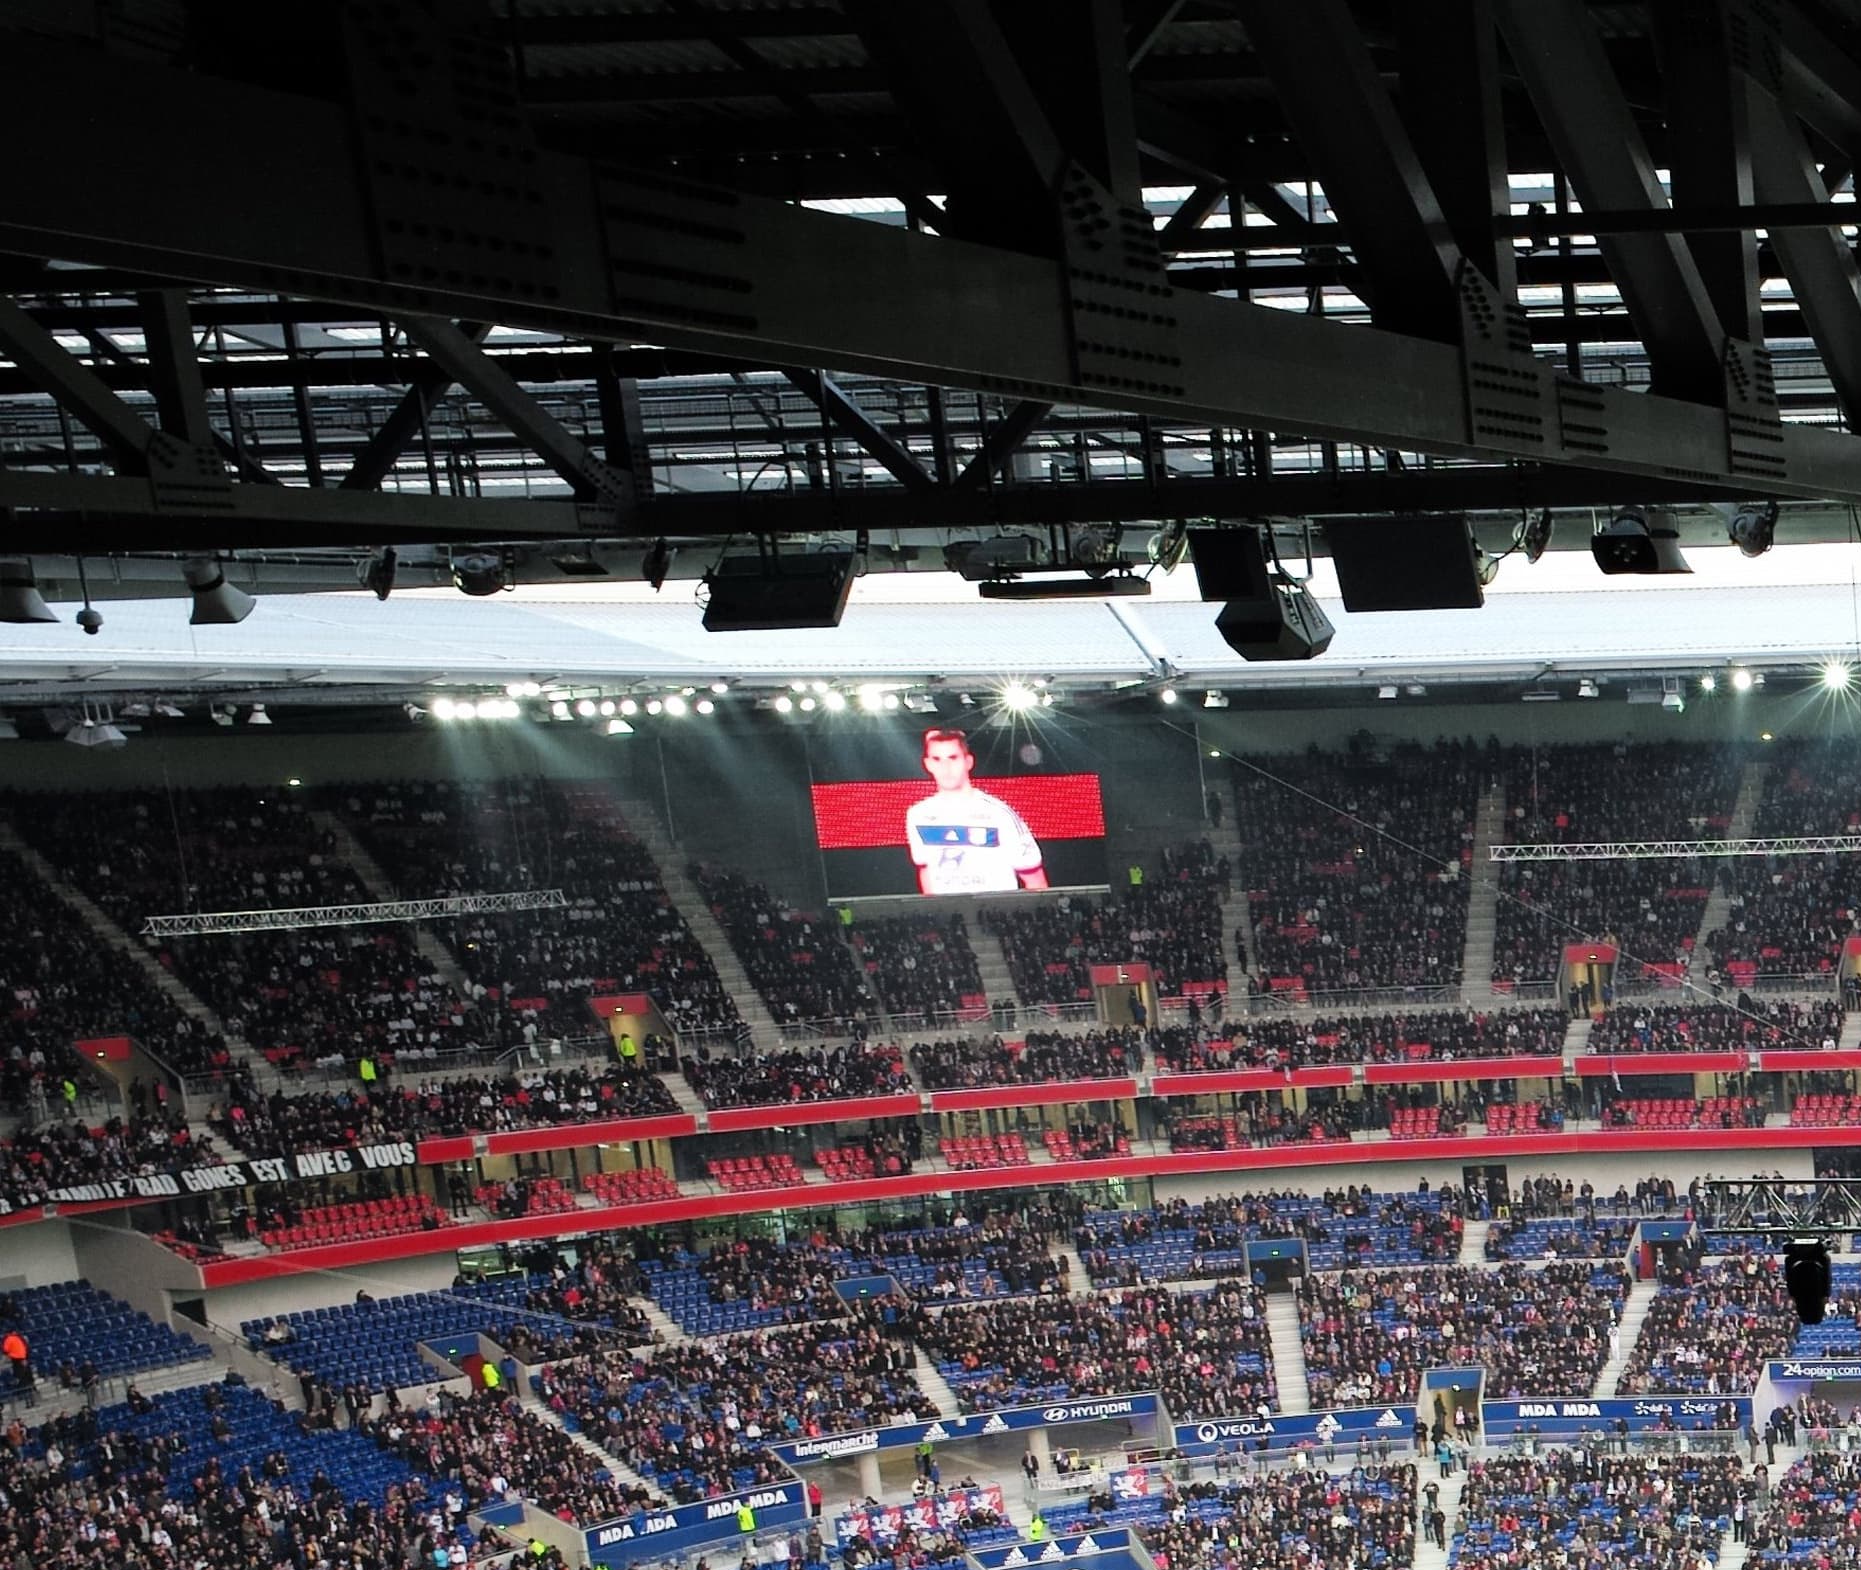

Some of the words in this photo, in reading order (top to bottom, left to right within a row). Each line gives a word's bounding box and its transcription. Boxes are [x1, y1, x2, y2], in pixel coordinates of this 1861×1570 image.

[250, 1157, 288, 1182] EST
[295, 1149, 351, 1177] AVEC
[360, 1142, 414, 1169] VOUS
[1071, 1402, 1132, 1418] HYUNDAI
[1519, 1404, 1557, 1417] MDA
[1563, 1404, 1600, 1416] MDA
[750, 1490, 788, 1509] MDA
[600, 1524, 635, 1546] MDA
